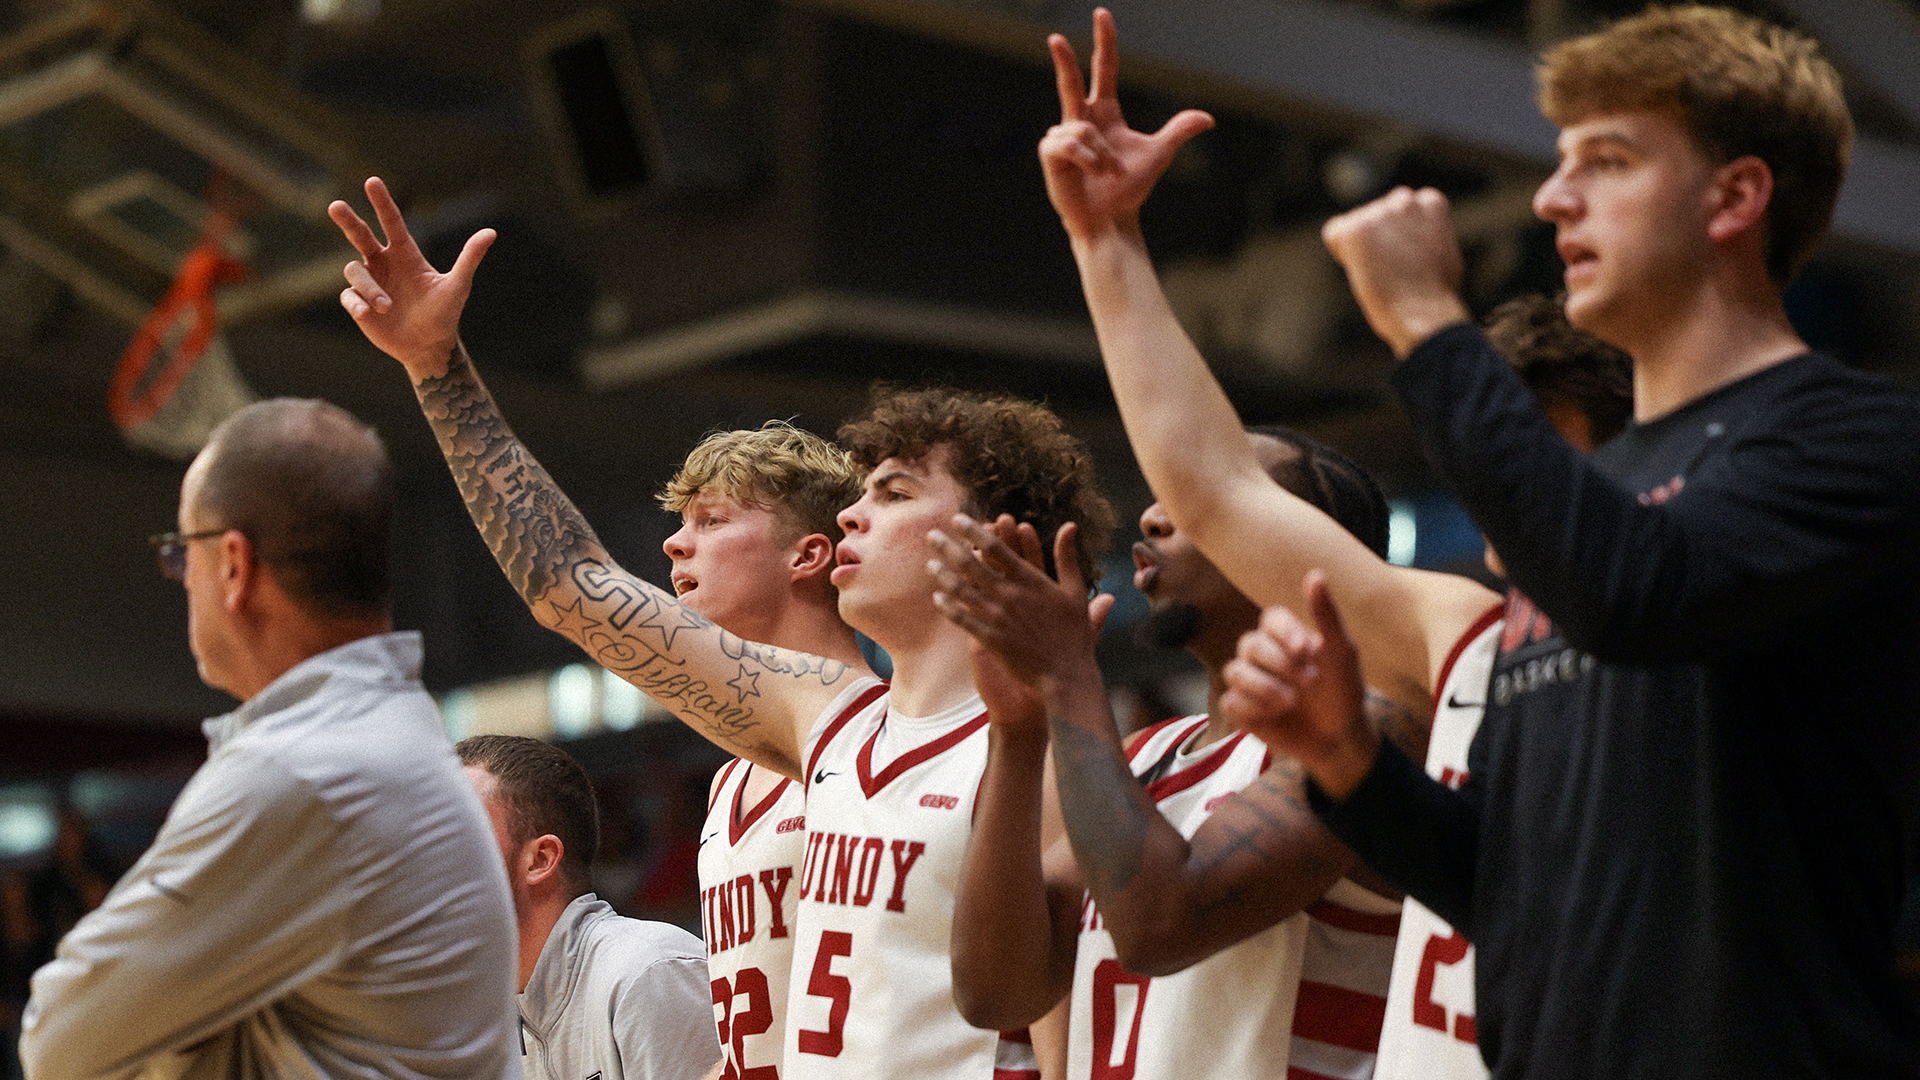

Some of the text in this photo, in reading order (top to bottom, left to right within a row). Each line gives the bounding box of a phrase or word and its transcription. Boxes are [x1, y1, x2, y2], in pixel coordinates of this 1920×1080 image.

[590, 631, 761, 737] Tiffany
[799, 930, 852, 1058] 5
[1091, 958, 1152, 1080] 0
